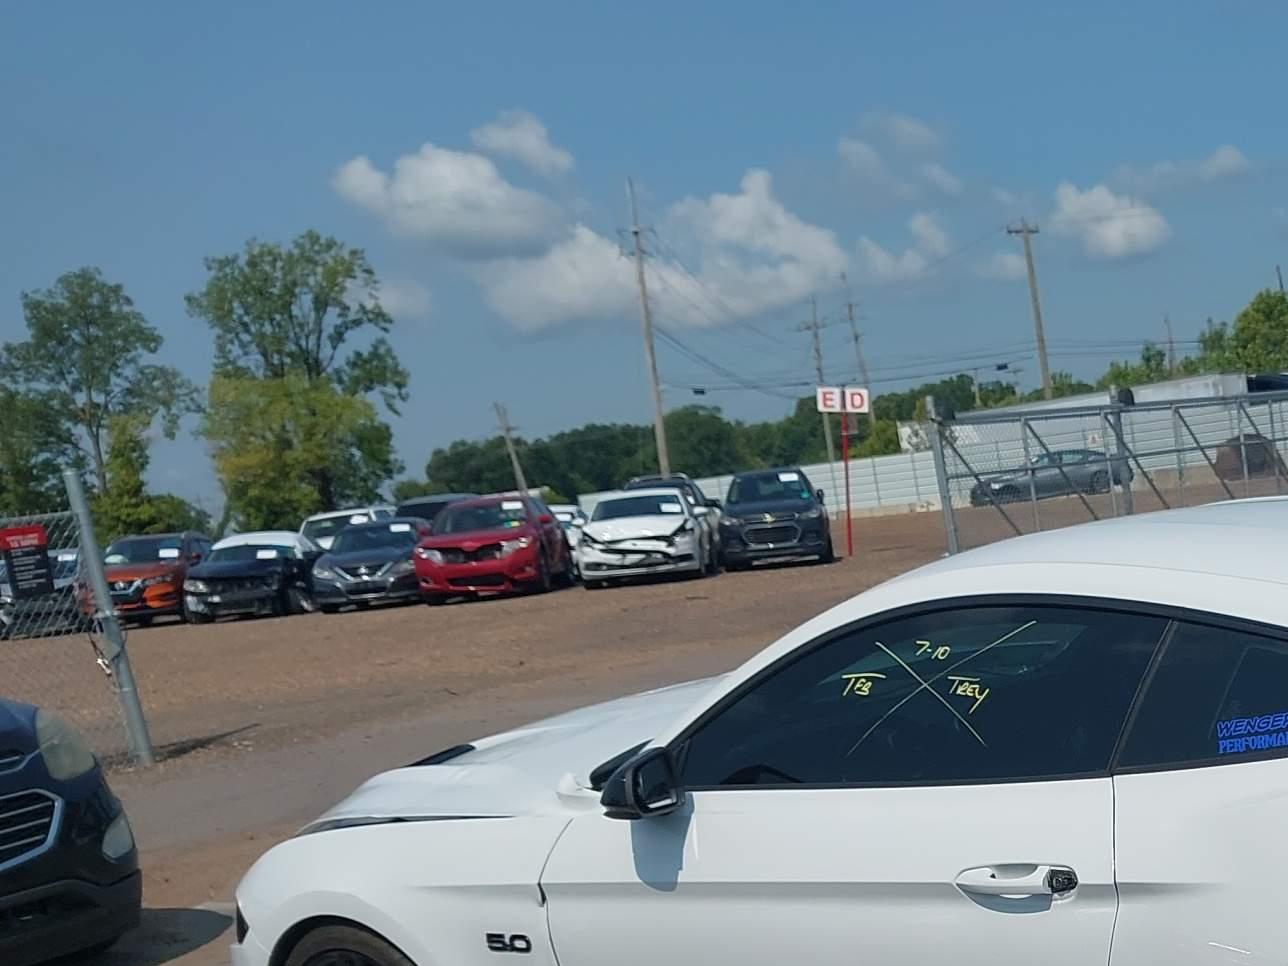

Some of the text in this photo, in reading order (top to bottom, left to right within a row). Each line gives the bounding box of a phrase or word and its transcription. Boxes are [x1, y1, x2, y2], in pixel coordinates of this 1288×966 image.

[822, 391, 865, 410] E D
[915, 640, 951, 660] 7-10
[947, 675, 990, 714] TREY
[486, 932, 532, 954] 5.0
